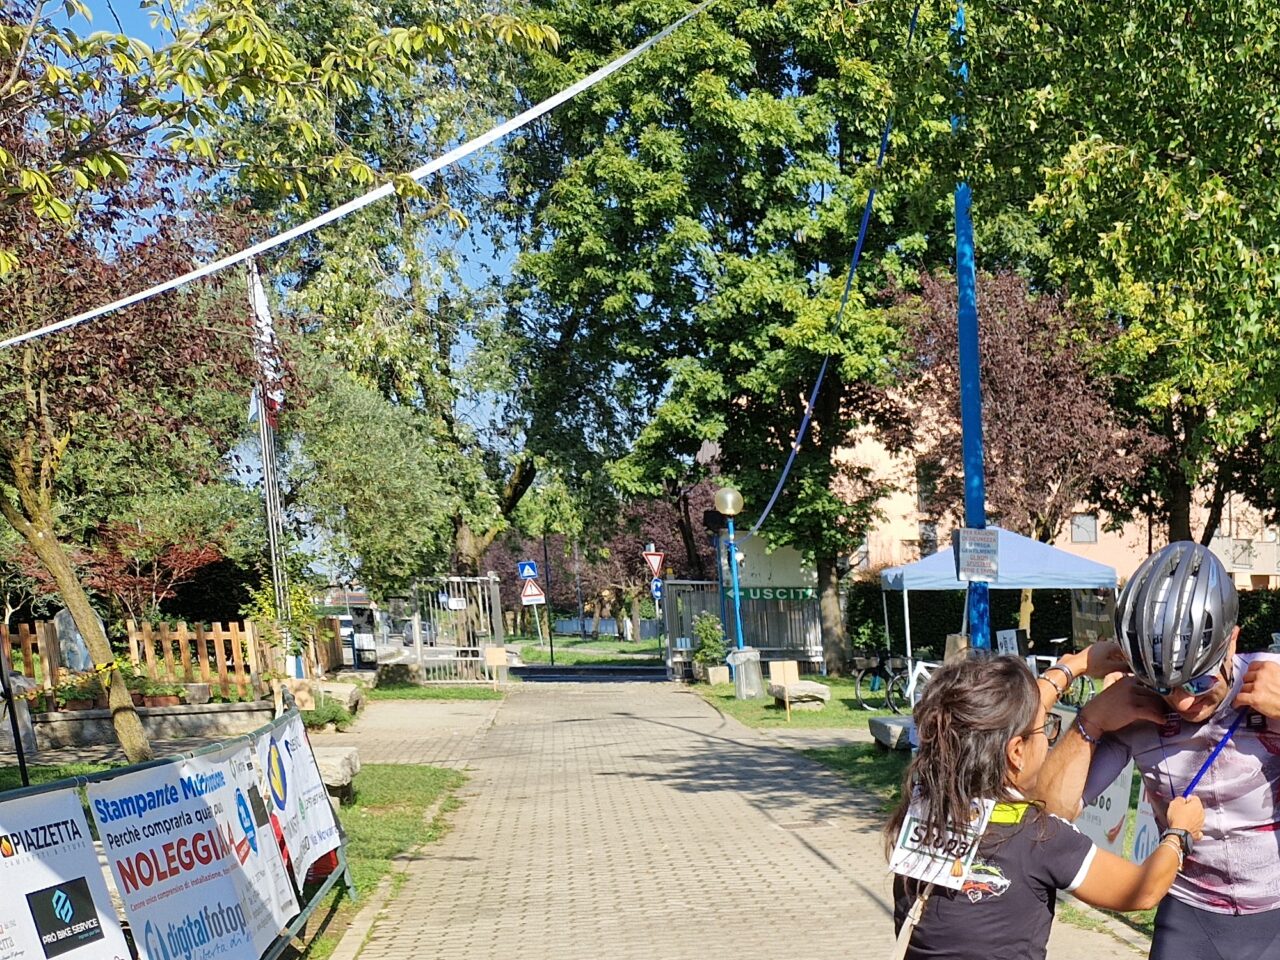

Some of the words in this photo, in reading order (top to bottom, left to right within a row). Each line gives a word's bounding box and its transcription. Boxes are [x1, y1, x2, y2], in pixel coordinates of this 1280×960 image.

[750, 588, 818, 599] USCITA
[95, 783, 179, 823] Stampante
[10, 819, 82, 854] PIAZZETTA
[106, 820, 141, 849] Perchè
[142, 811, 193, 842] comprarla
[42, 932, 57, 945] PRO
[57, 927, 73, 940] BIKE
[73, 918, 99, 934] SERVICE
